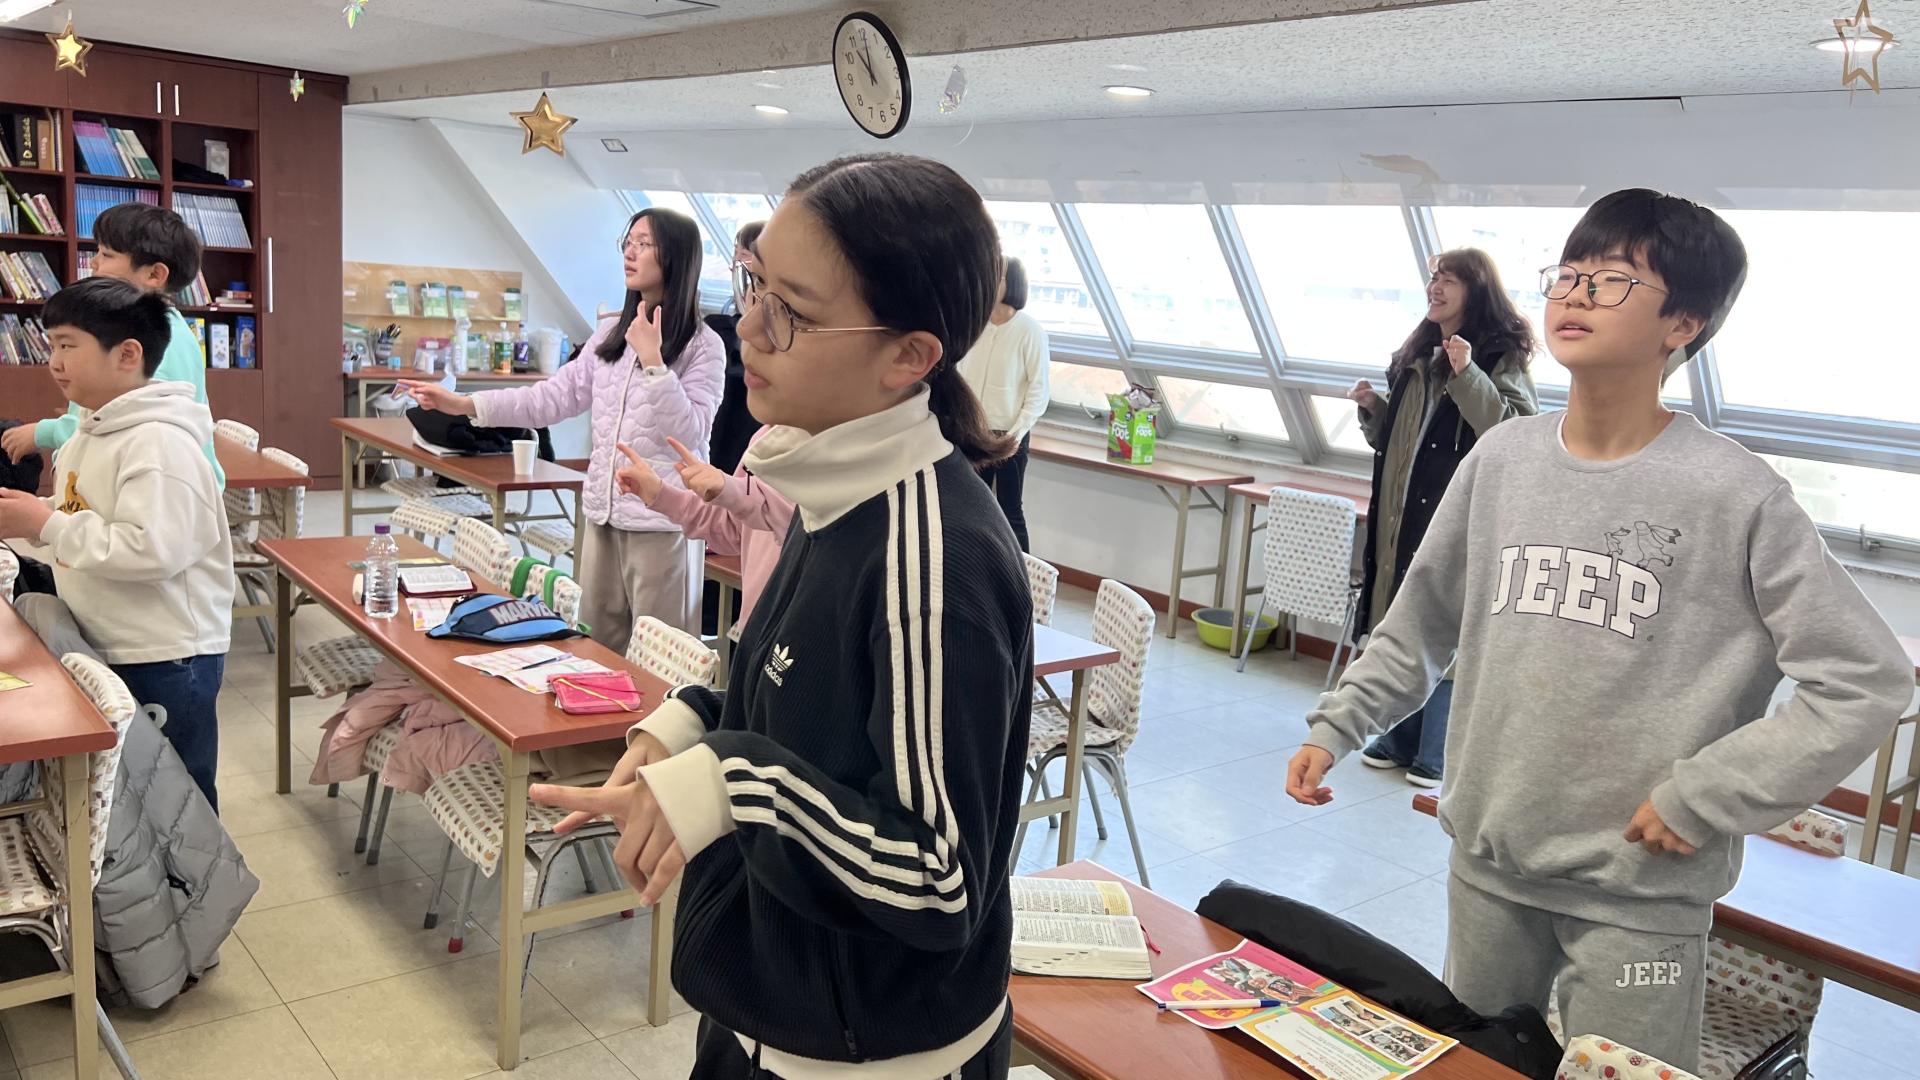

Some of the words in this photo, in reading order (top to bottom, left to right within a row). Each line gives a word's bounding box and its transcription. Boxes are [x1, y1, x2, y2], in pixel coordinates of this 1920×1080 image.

[858, 28, 867, 41] 12
[872, 33, 879, 44] 1
[849, 36, 857, 47] 11
[845, 52, 854, 65] 10
[884, 46, 891, 59] 2
[847, 73, 854, 86] 9
[893, 67, 900, 80] 3
[857, 94, 864, 107] 8
[895, 89, 901, 101] 4
[868, 107, 874, 118] 7
[880, 110, 887, 123] 6
[890, 104, 897, 116] 5
[1490, 545, 1662, 639] JEEP
[764, 663, 783, 687] adidas
[1615, 961, 1682, 988] JEEP
